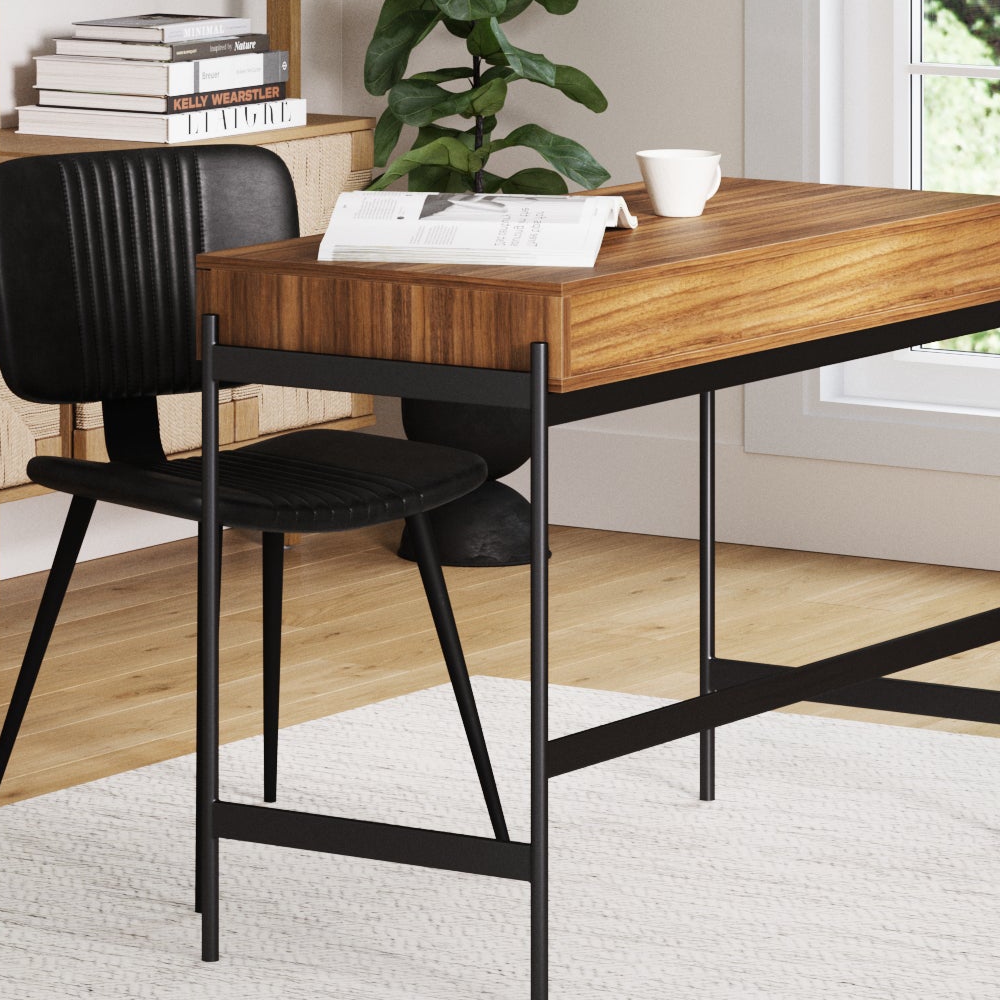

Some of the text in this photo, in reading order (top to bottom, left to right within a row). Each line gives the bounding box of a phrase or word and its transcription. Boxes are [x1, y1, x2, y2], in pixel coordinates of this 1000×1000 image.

[183, 24, 225, 38] MINIMAL
[233, 40, 257, 52] Nature
[173, 86, 280, 112] KELLY WEARSTLER
